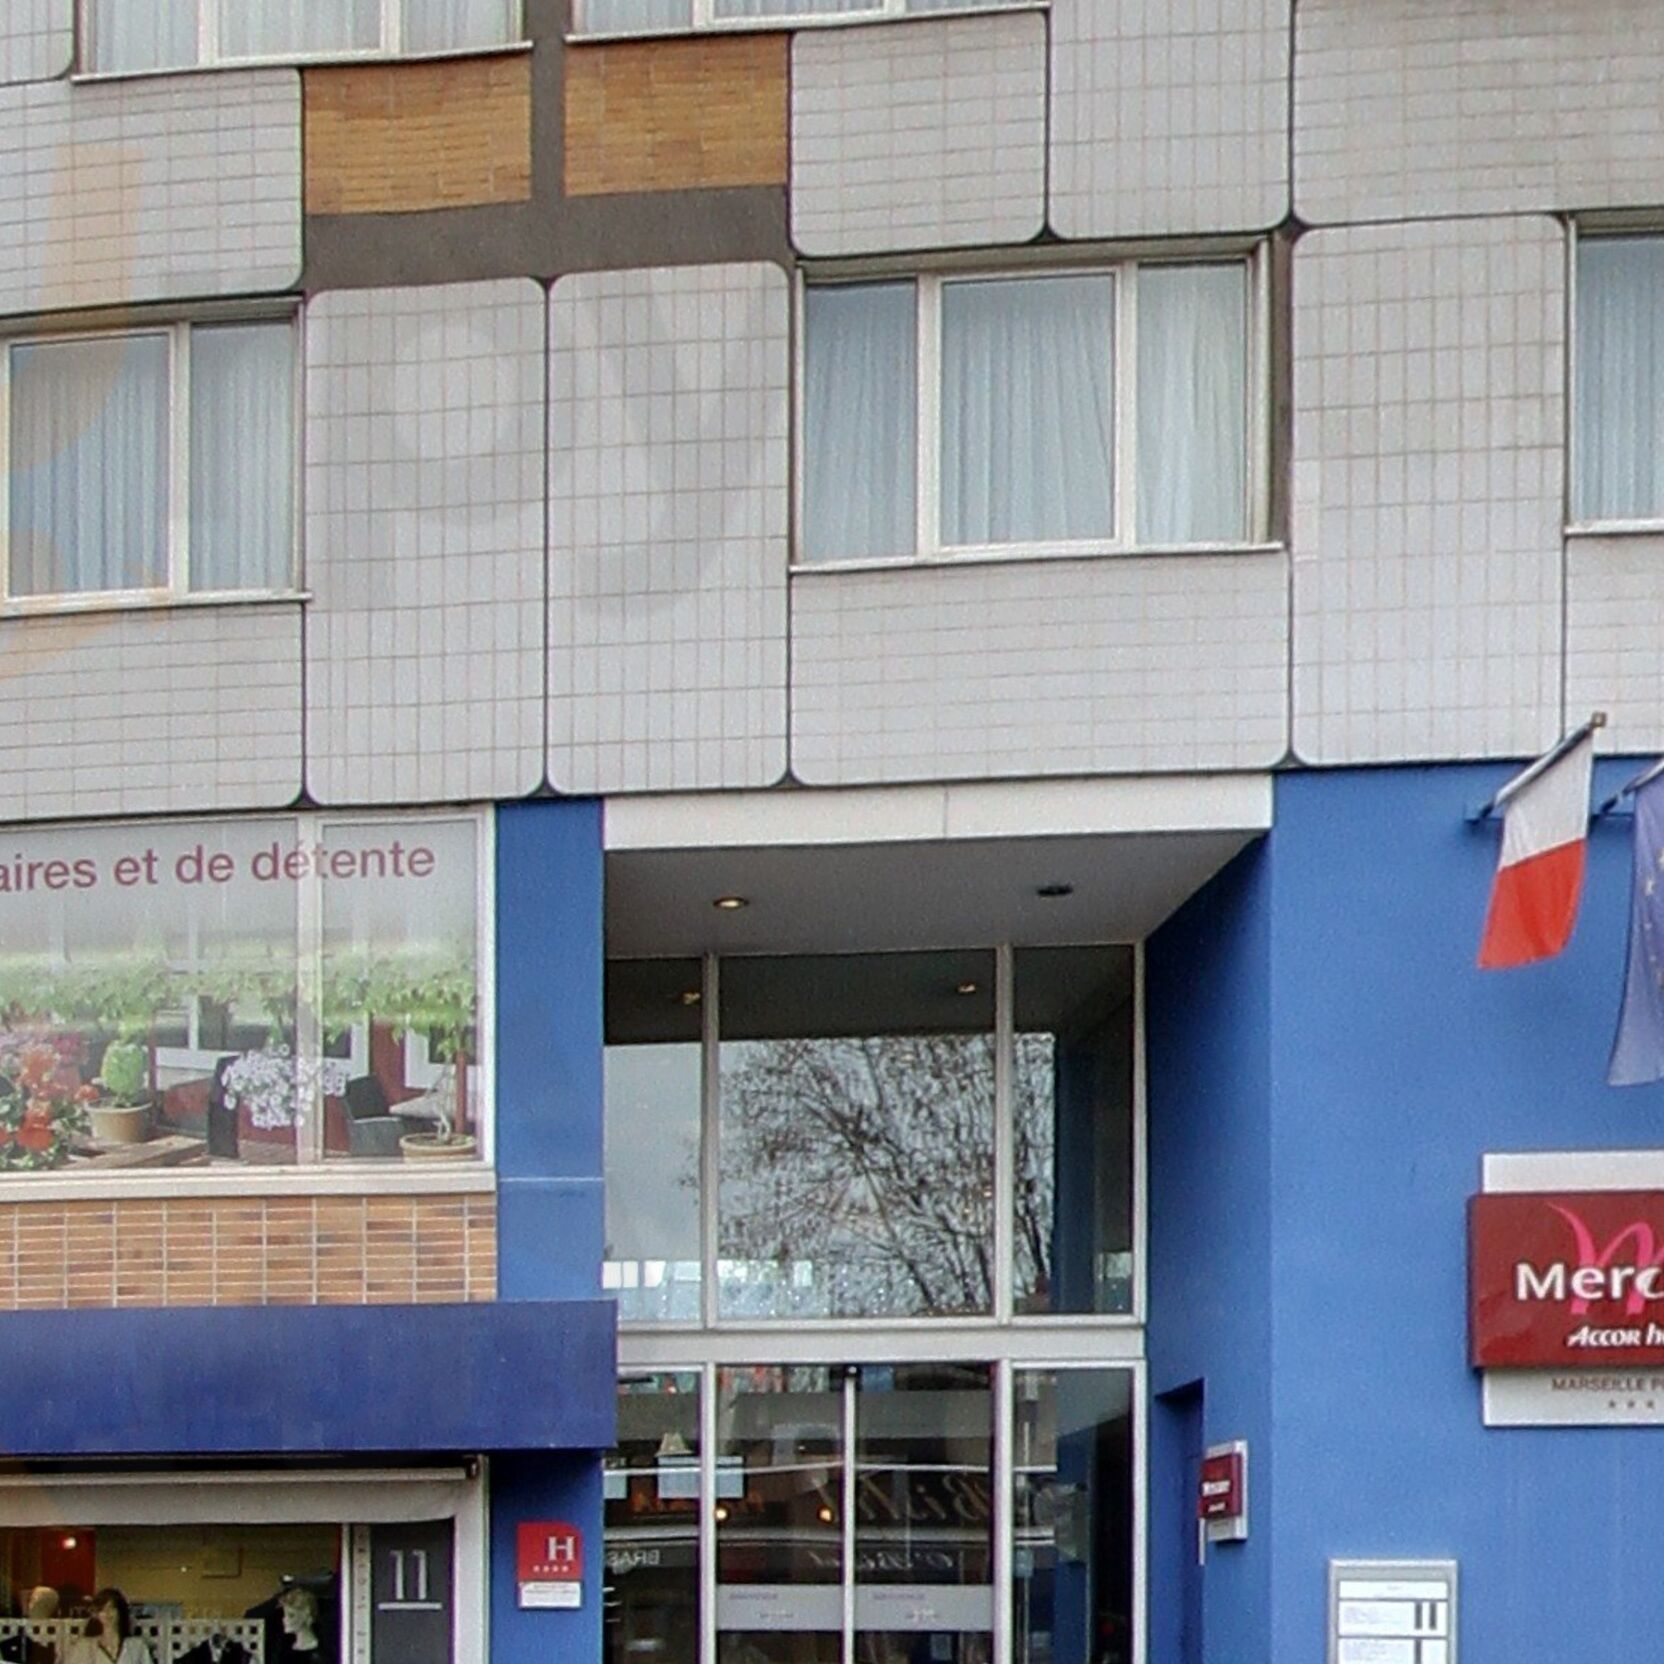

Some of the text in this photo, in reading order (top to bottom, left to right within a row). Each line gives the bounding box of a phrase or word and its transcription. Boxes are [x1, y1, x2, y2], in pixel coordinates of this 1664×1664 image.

[114, 849, 159, 886] et
[174, 843, 235, 884] de
[251, 838, 436, 880] détente
[1552, 1377, 1645, 1393] MARSEILLE
[548, 1535, 576, 1562] H
